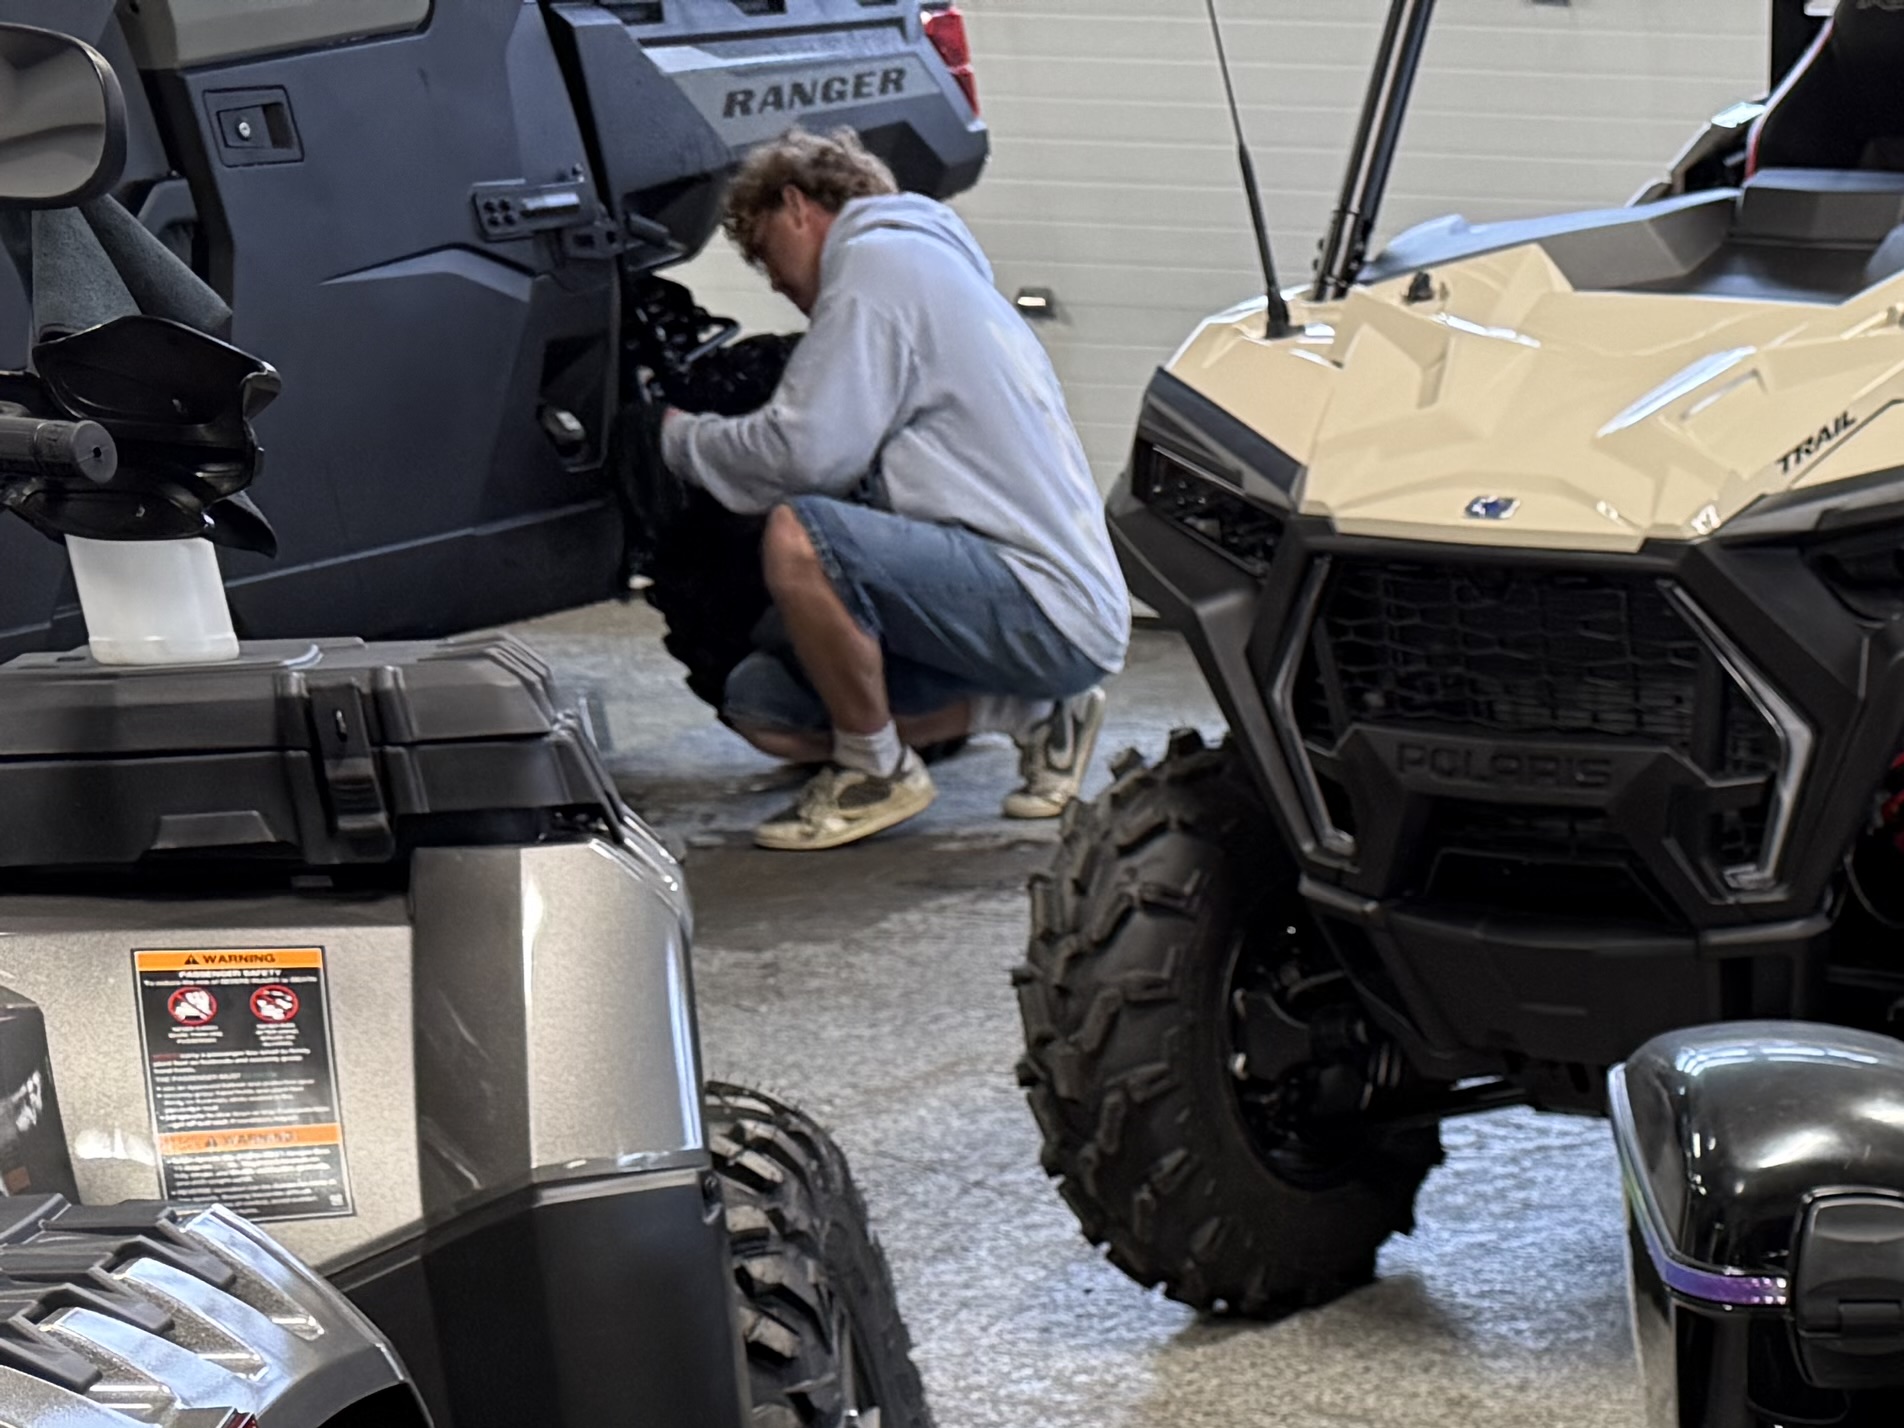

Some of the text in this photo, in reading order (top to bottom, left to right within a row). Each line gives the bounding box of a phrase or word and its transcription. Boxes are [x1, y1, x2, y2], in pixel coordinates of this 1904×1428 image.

[722, 67, 908, 119] RANGER
[1775, 409, 1857, 474] TRAIL
[1396, 742, 1613, 788] POLARIS
[203, 953, 276, 964] WARNING
